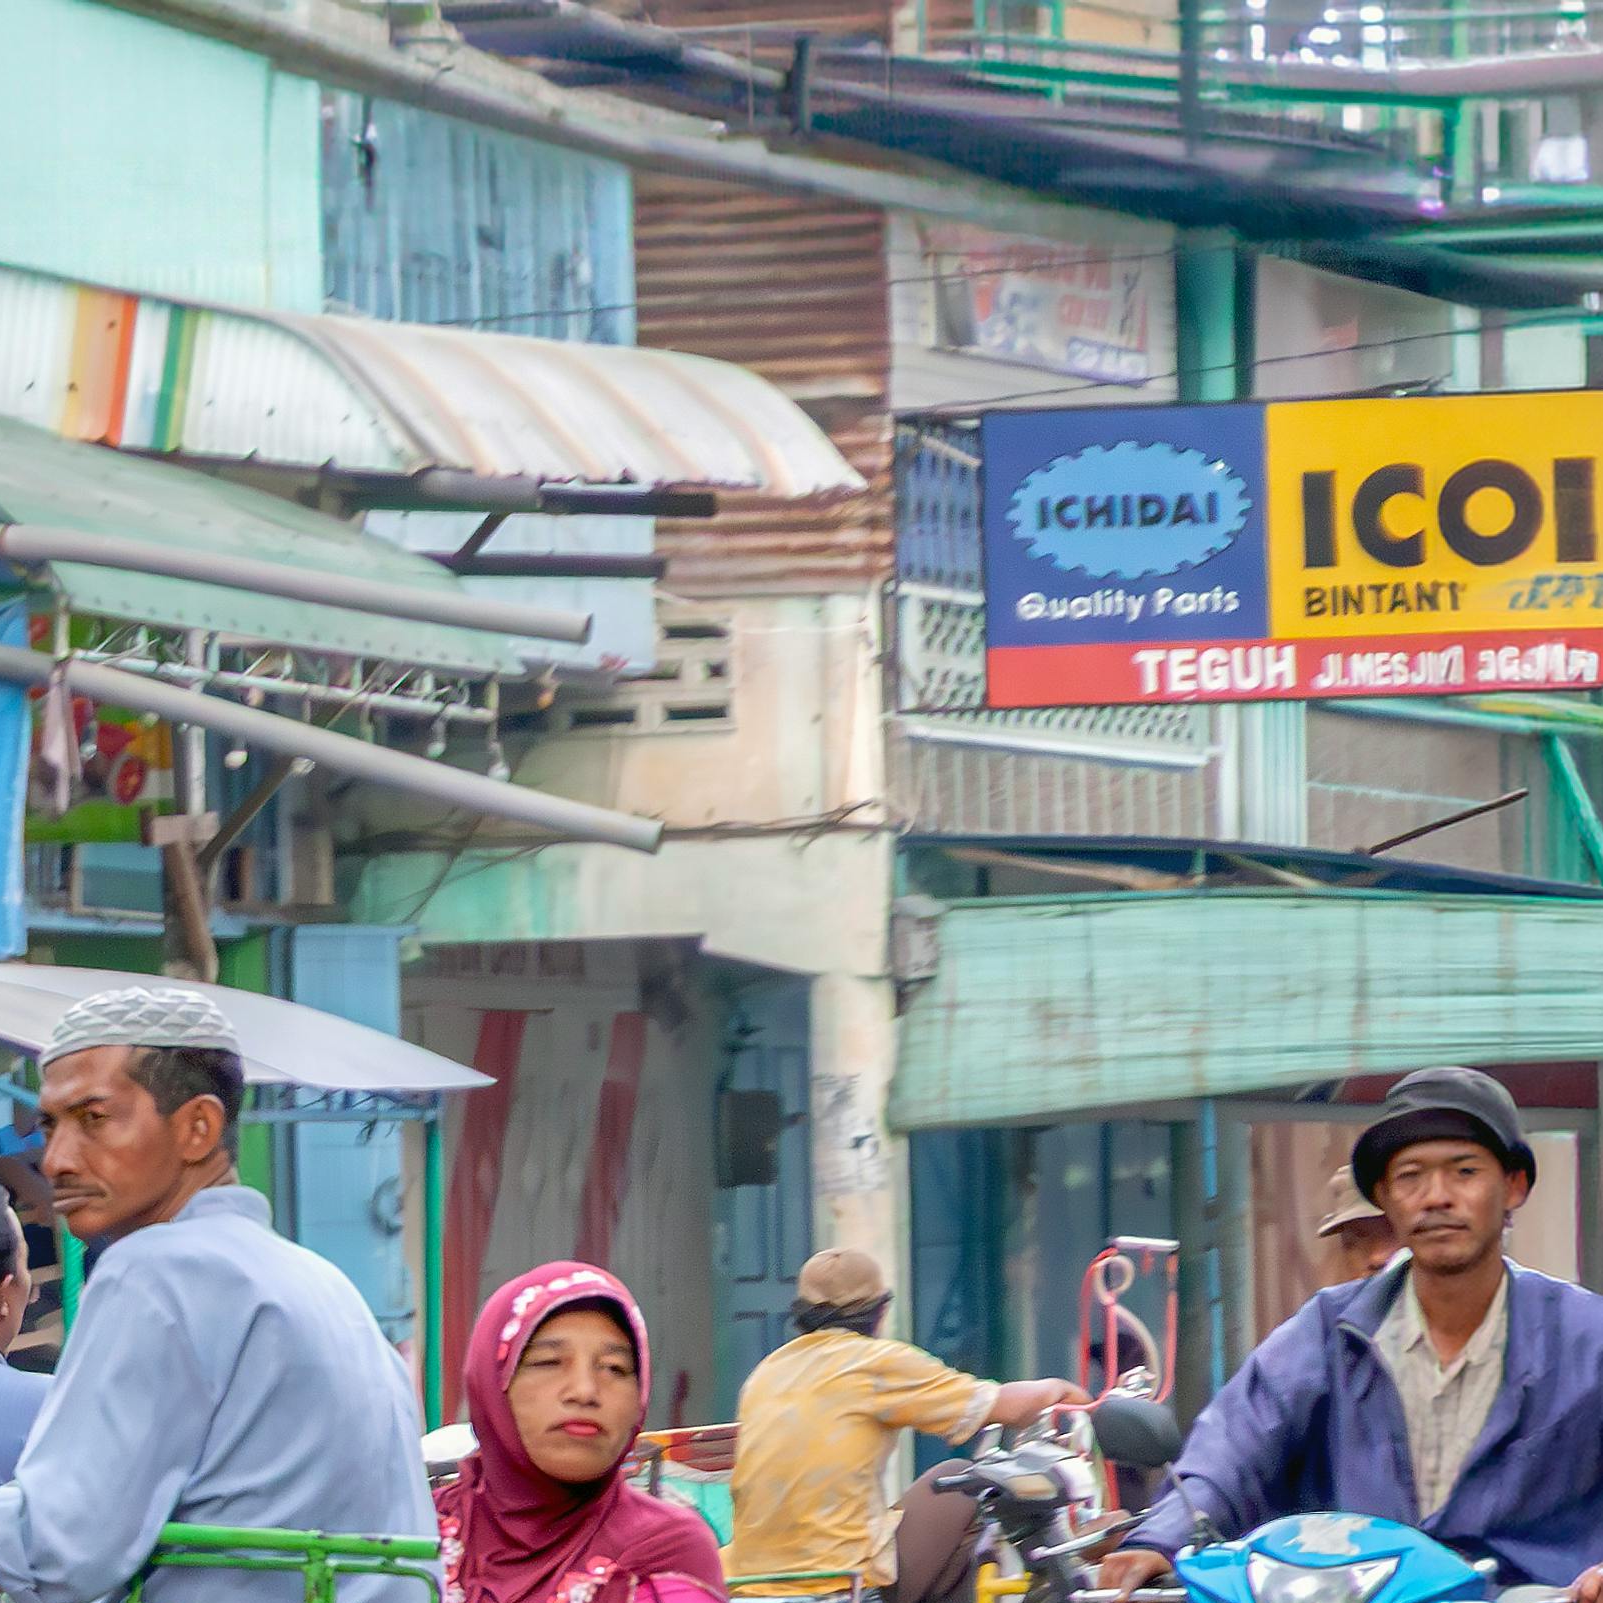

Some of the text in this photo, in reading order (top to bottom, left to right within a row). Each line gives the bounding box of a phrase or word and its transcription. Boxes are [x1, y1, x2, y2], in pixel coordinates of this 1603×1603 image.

[1035, 491, 1219, 530] ICHIDAI
[1015, 585, 1240, 623] Quality Parts
[1131, 644, 1297, 696] TEGUH
